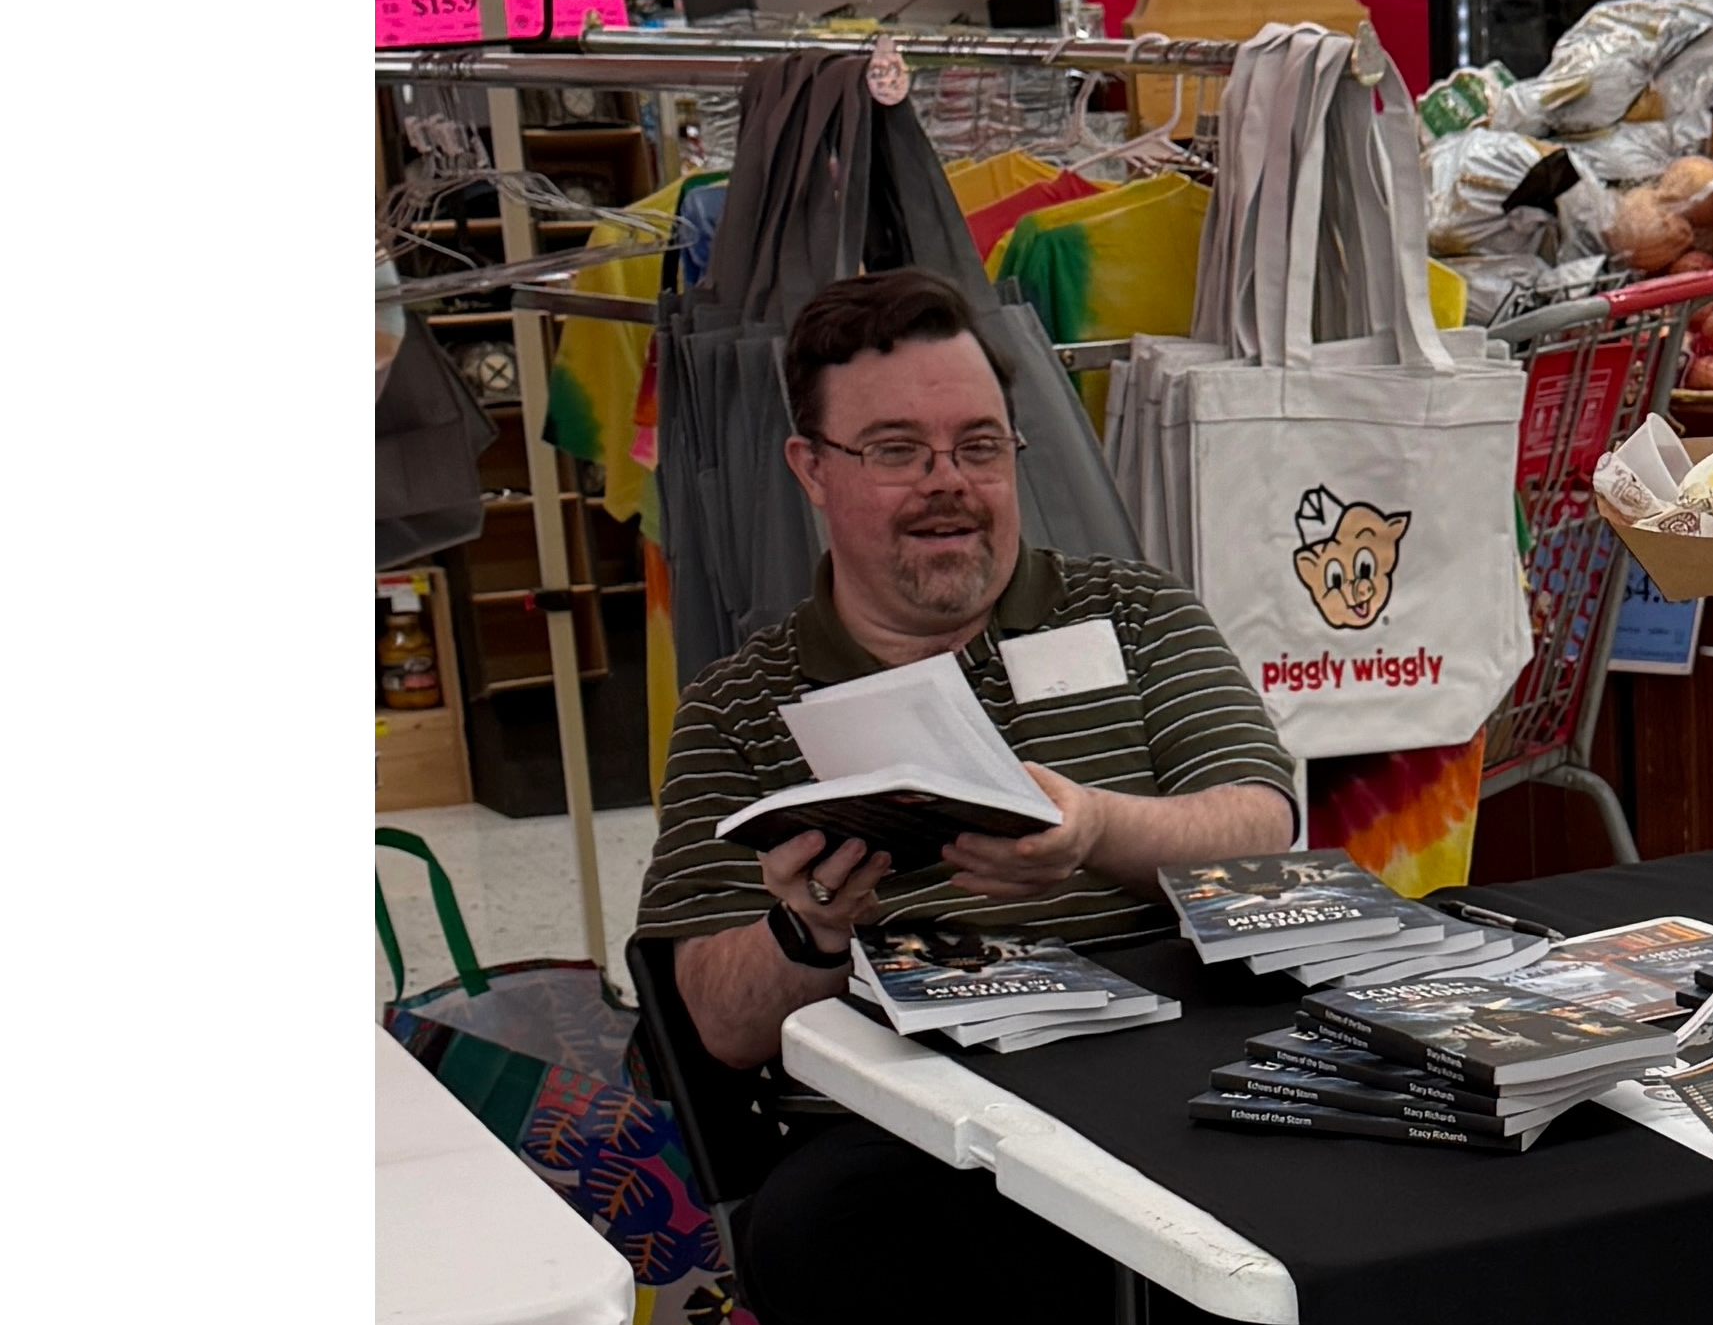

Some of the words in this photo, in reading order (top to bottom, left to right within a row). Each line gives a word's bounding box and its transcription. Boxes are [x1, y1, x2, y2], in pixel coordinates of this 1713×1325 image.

[1262, 650, 1346, 693] piggly
[1352, 646, 1443, 688] wiggly
[1227, 907, 1319, 926] STORM
[1347, 982, 1447, 1001] ECHOES
[1400, 985, 1489, 1002] STORM
[1247, 1080, 1273, 1093] Echoes
[1296, 1089, 1318, 1100] Storm
[1231, 1109, 1260, 1121] Echoes
[1286, 1115, 1312, 1126] Storm
[1403, 1106, 1423, 1120] Stacy
[1424, 1110, 1457, 1124] Richards
[1408, 1127, 1431, 1140] Stacy
[1432, 1130, 1468, 1143] Richards
